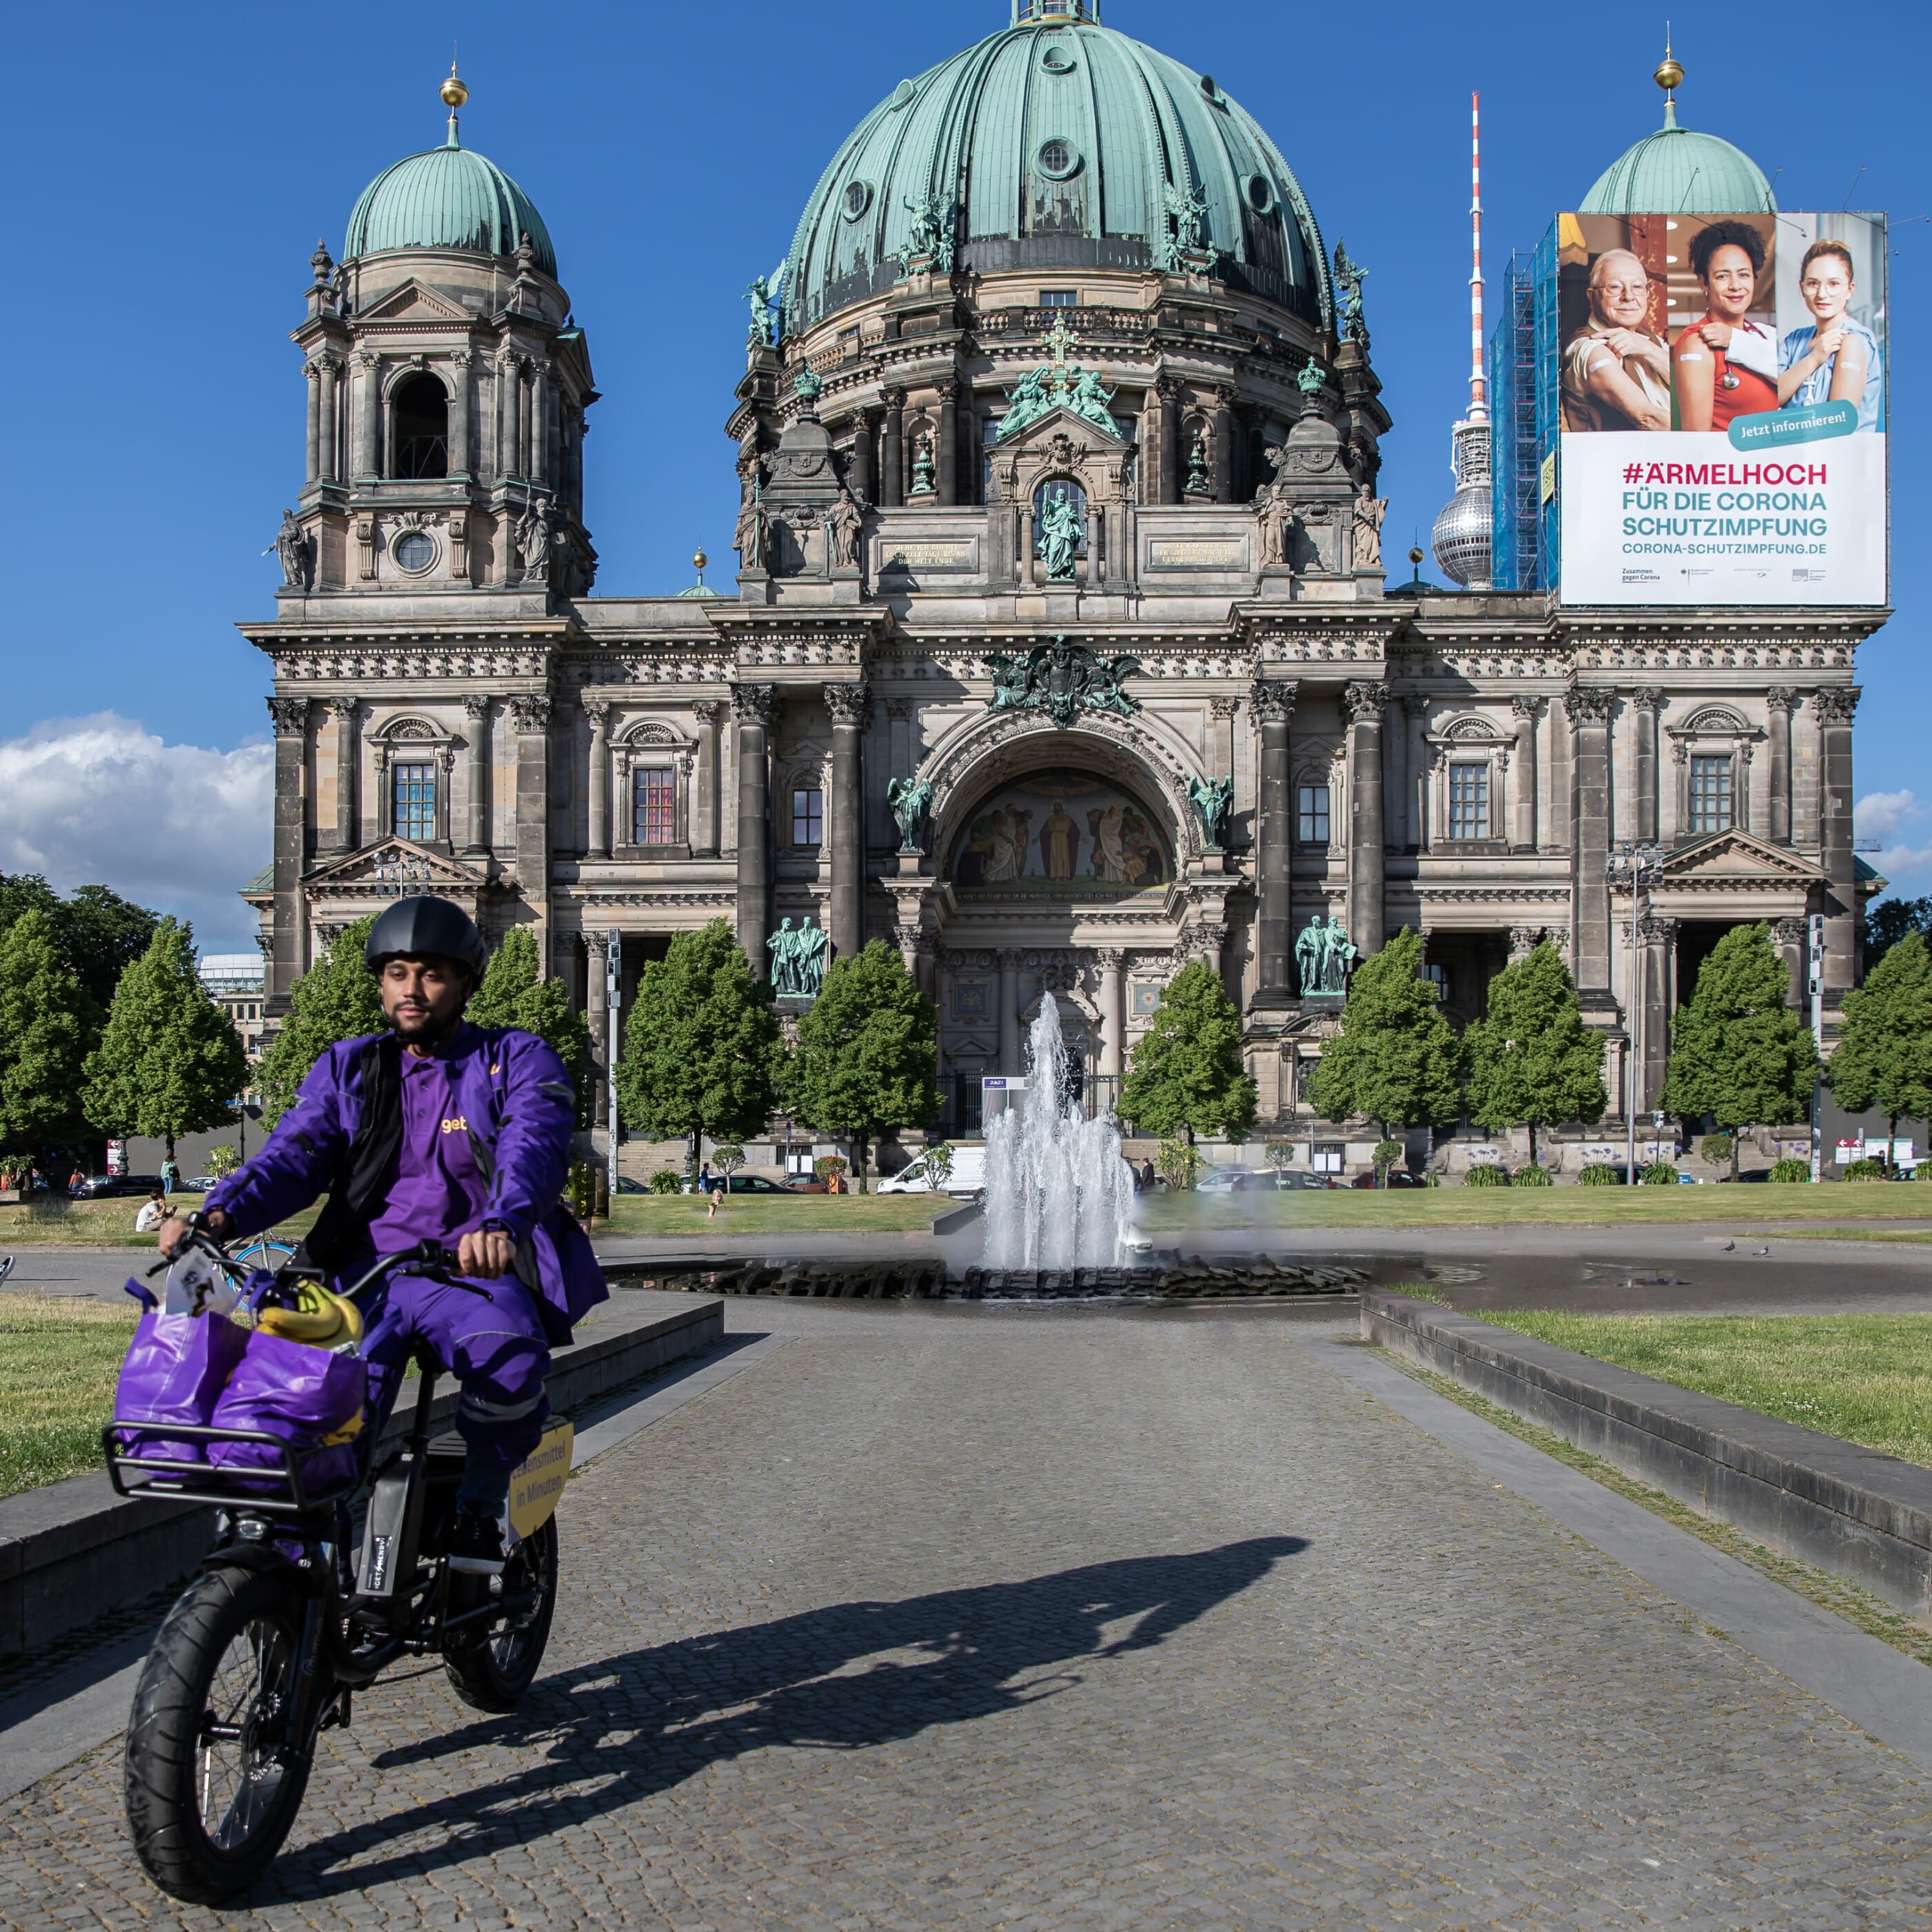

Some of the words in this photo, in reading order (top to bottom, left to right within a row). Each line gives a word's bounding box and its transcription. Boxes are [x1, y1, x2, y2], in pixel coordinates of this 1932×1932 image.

[1741, 424, 1770, 438] Jetzt
[1772, 411, 1847, 433] informieren!
[1623, 462, 1826, 485] #ÄRMELHOCH
[1623, 487, 1668, 510] FÜR
[1675, 492, 1711, 510] DIE
[1716, 492, 1827, 511] CORONA
[1623, 517, 1827, 537] SCHUTZIMPFUNG
[1622, 543, 1826, 555] CORONA-SCHUTZIMPFUNG.DE
[516, 1490, 525, 1509] in
[527, 1474, 562, 1503] Minuten
